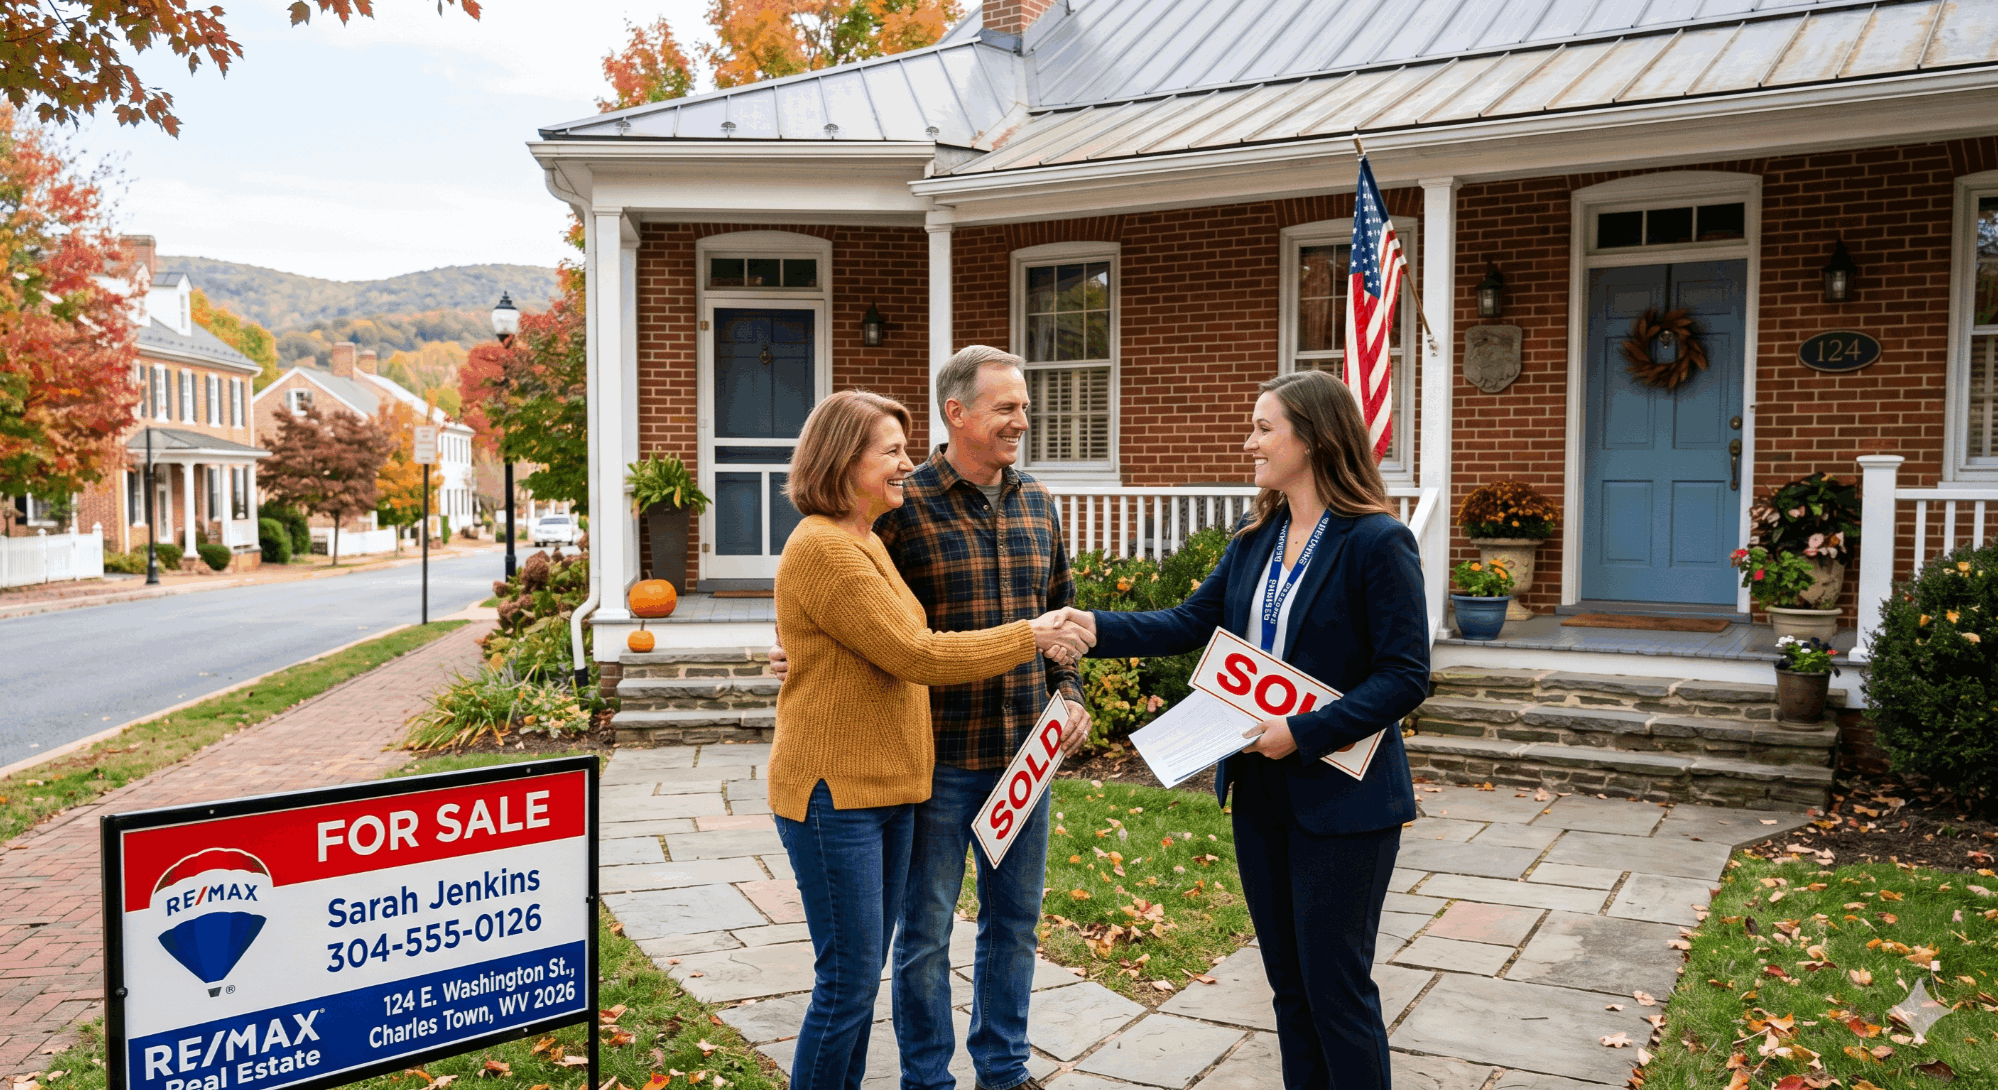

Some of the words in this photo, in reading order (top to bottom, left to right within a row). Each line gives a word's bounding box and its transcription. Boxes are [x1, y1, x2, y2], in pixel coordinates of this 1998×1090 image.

[1816, 338, 1862, 362] 124
[990, 719, 1063, 840] SOLD
[317, 809, 419, 863] FOR
[435, 789, 550, 843] SALE
[166, 883, 258, 917] RE/MAX
[327, 885, 418, 928] Sarah
[428, 867, 541, 910] Jenkins
[326, 903, 542, 973] 304-555-0126
[369, 1016, 438, 1049] Charles
[442, 1004, 494, 1031] Town,
[498, 991, 530, 1017] WV
[533, 980, 576, 1009] 2026
[383, 989, 415, 1017] 124
[420, 985, 437, 1009] E.
[442, 964, 545, 1003] Washington
[548, 956, 575, 979] St.,
[144, 1009, 321, 1081] RE/MAX
[237, 1049, 321, 1085] Estate
